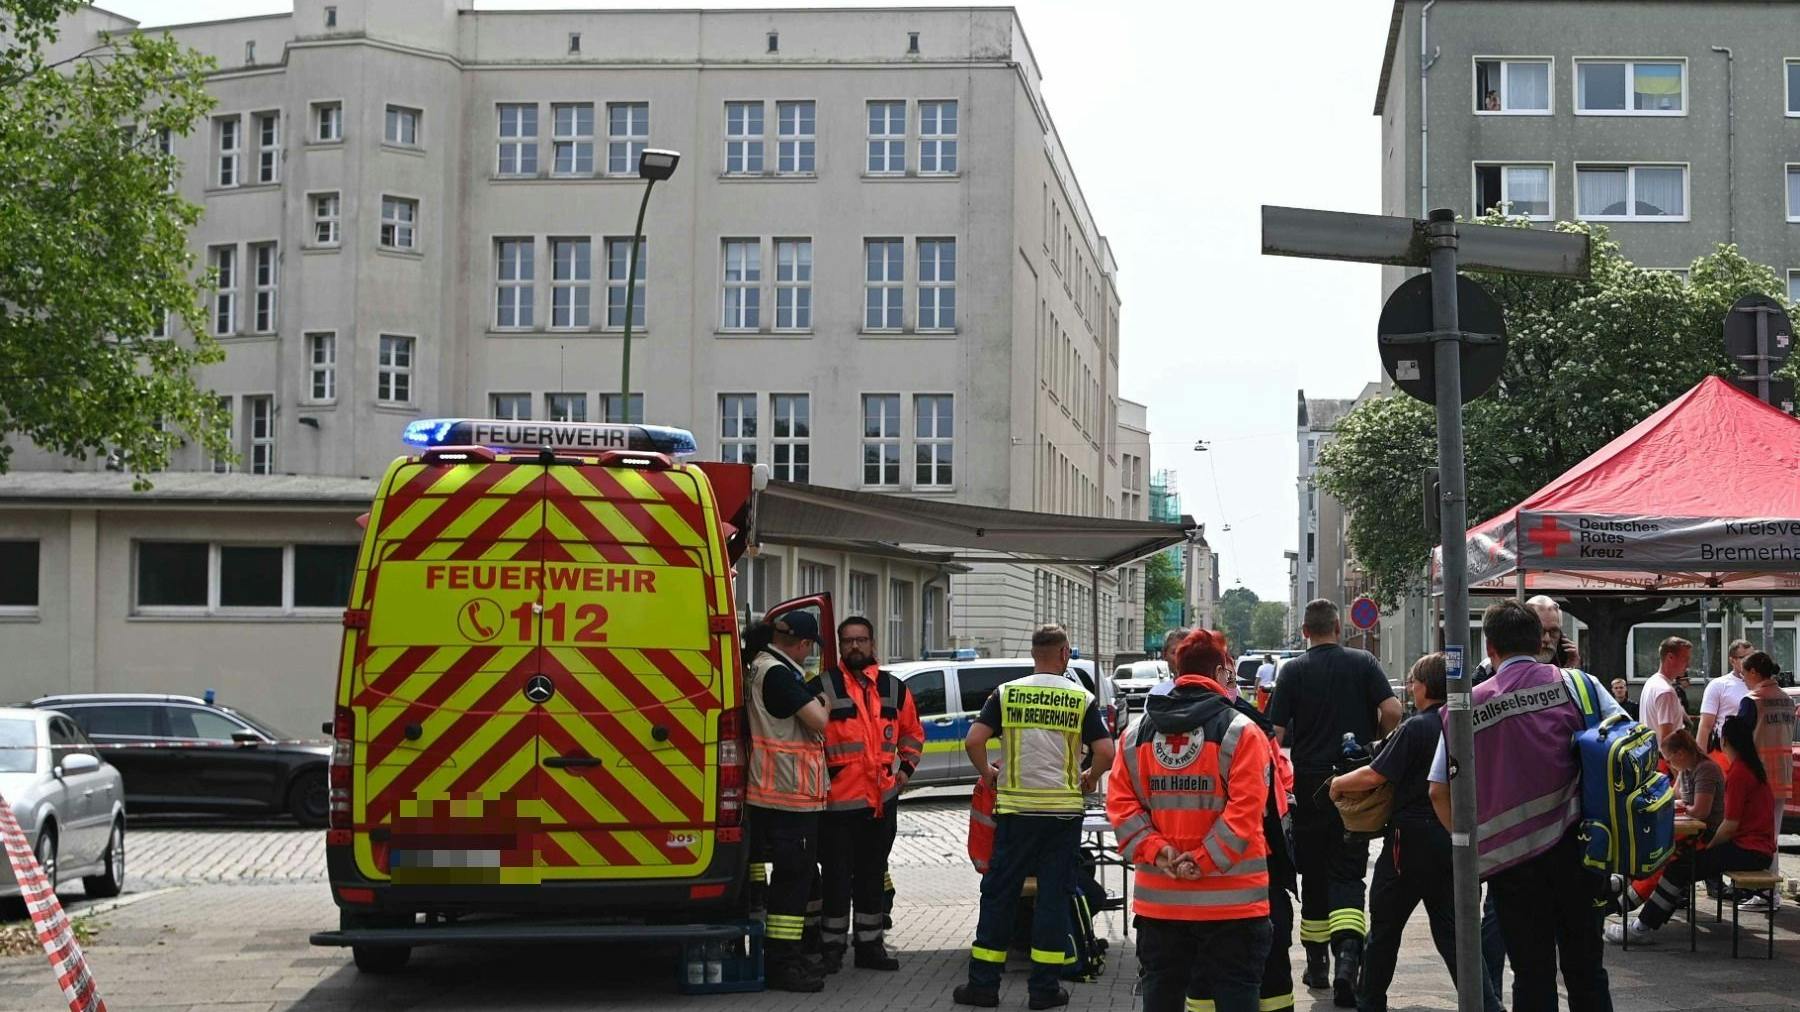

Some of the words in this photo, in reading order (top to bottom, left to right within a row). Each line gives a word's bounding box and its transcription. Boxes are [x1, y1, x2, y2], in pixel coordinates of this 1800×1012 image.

[475, 424, 626, 447] FEUERWEHR
[1579, 518, 1660, 532] Deutsches
[1580, 531, 1625, 544] Rotes
[1580, 545, 1625, 558] Kreuz
[426, 566, 656, 593] FEUERWEHR
[510, 602, 609, 642] 112
[1008, 688, 1082, 709] Einsatzleiter
[1473, 687, 1560, 726] tfallseelsorger
[1007, 707, 1022, 723] THW
[1024, 708, 1080, 728] BREMERHAVEN
[1156, 742, 1173, 765] ROTES
[1175, 743, 1198, 765] KREUZ
[1149, 776, 1166, 790] and
[1171, 775, 1208, 791] Hadeln
